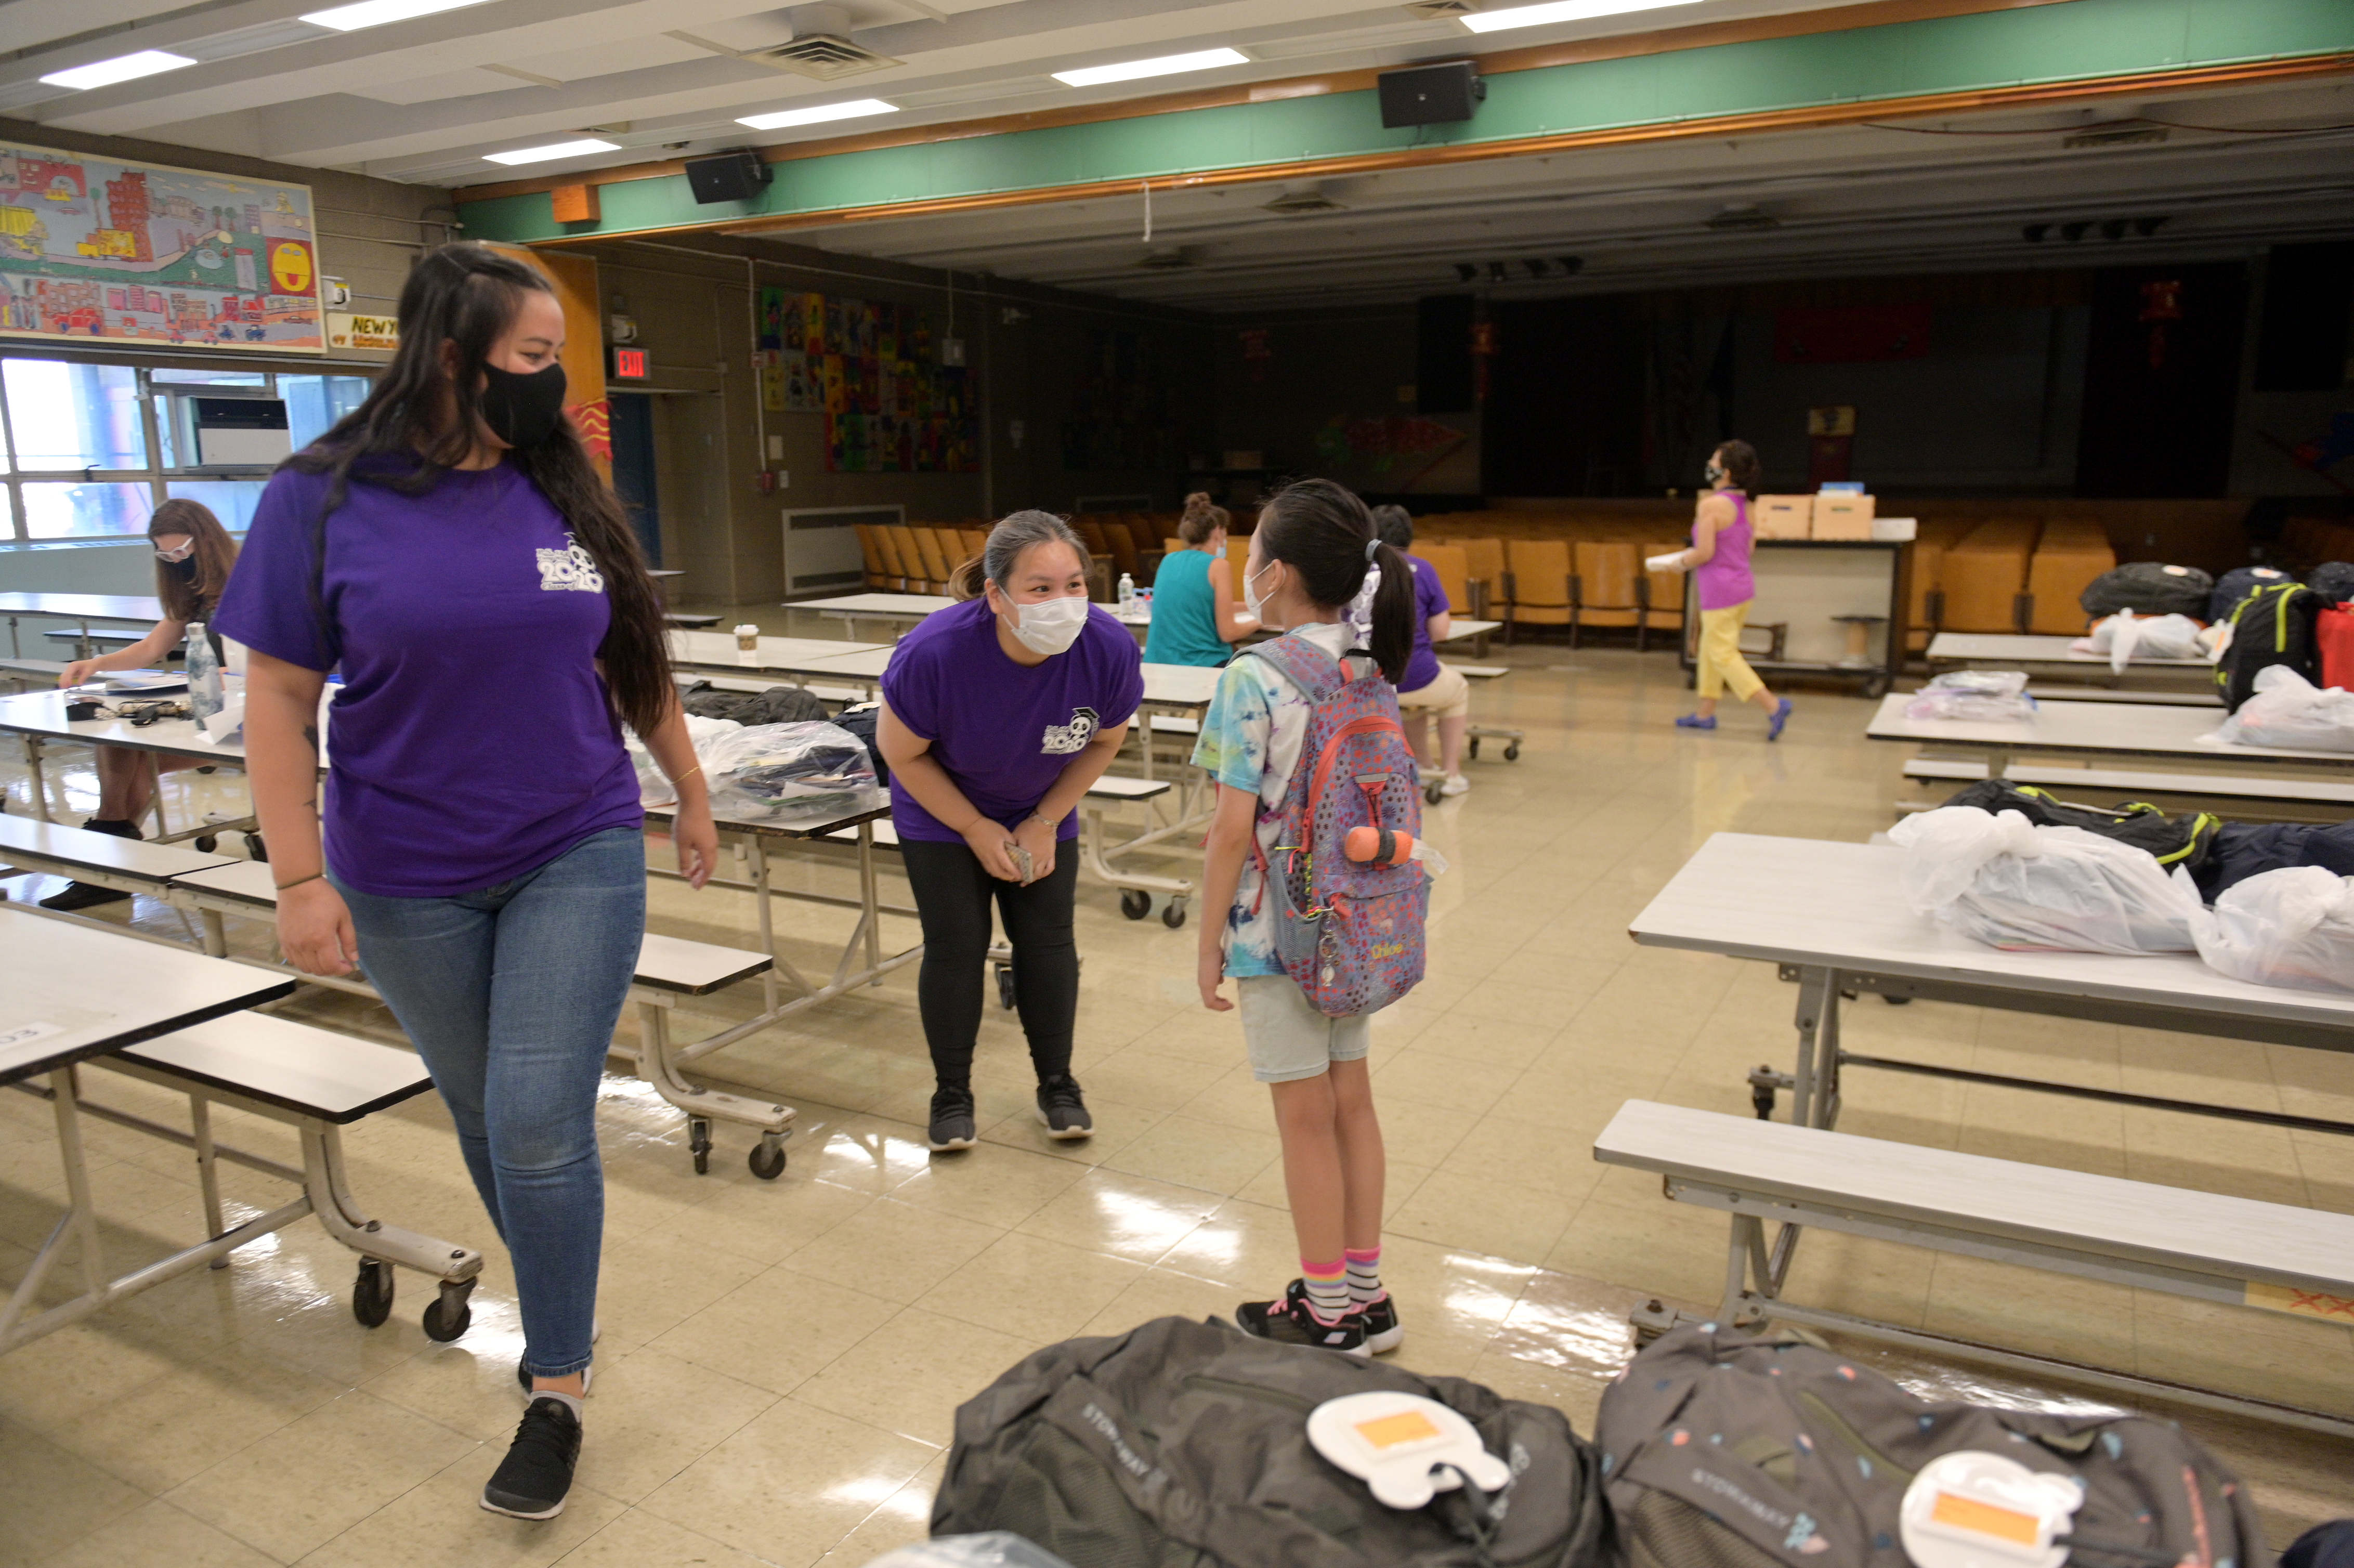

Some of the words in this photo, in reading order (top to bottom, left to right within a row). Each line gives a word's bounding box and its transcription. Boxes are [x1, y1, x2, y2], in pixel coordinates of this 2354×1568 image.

[352, 316, 386, 334] NEW
[619, 350, 644, 377] EXIT
[537, 560, 604, 593] 2020
[1042, 734, 1087, 753] 2020
[1371, 943, 1403, 959] Chloe
